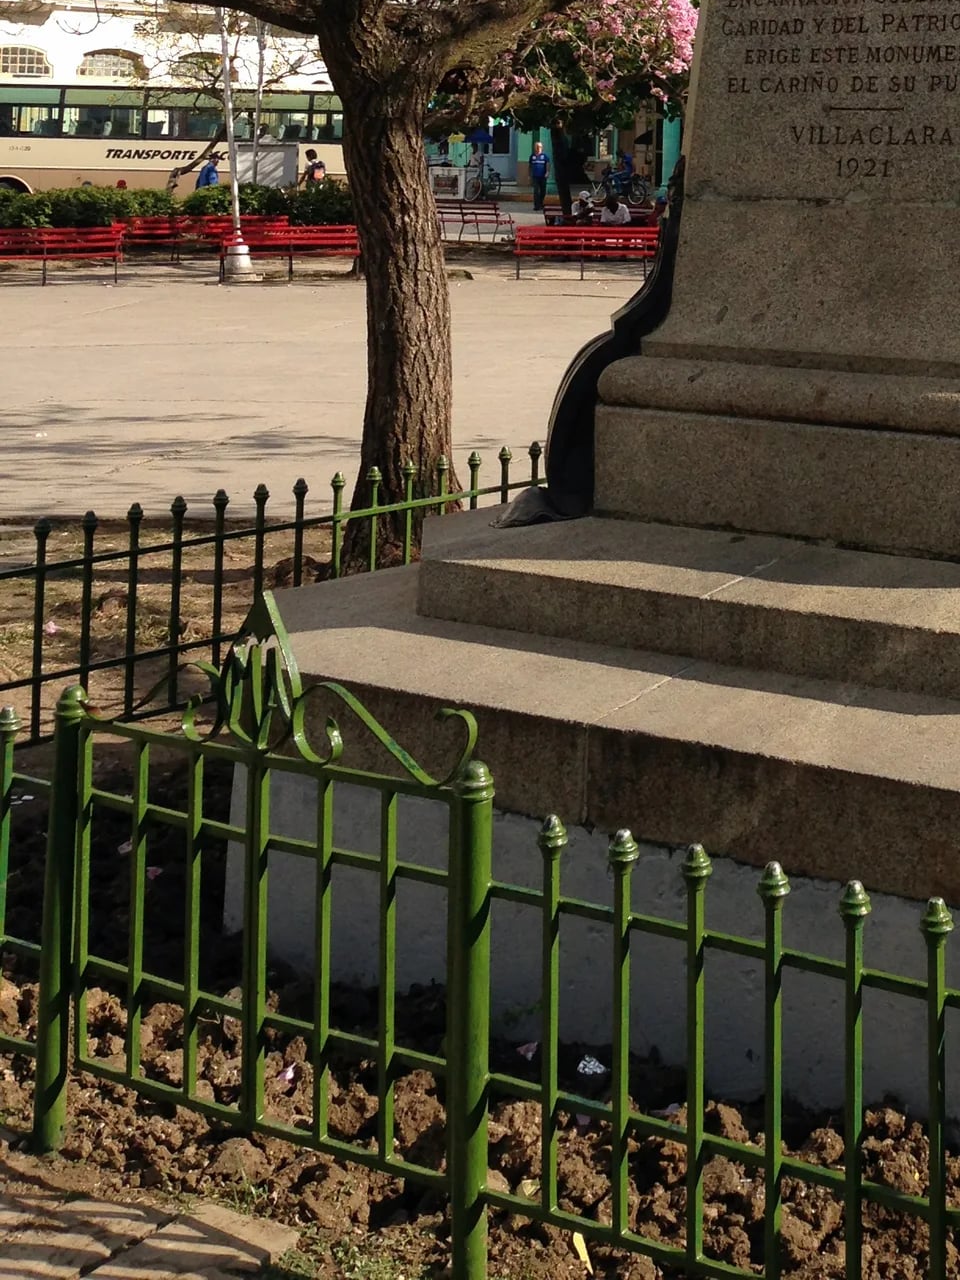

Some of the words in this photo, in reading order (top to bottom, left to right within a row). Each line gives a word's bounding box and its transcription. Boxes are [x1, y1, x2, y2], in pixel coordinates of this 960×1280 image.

[721, 17, 805, 37] CARIDAD
[812, 18, 826, 34] Y
[831, 15, 870, 35] DEL
[744, 48, 801, 65] ERIGE
[809, 47, 859, 65] ESTE
[726, 76, 751, 94] EL
[758, 70, 840, 94] CARIÑO
[850, 75, 879, 94] DE
[887, 75, 917, 93] SU
[104, 148, 199, 160] TRANSPORTE
[836, 156, 893, 179] 1921
